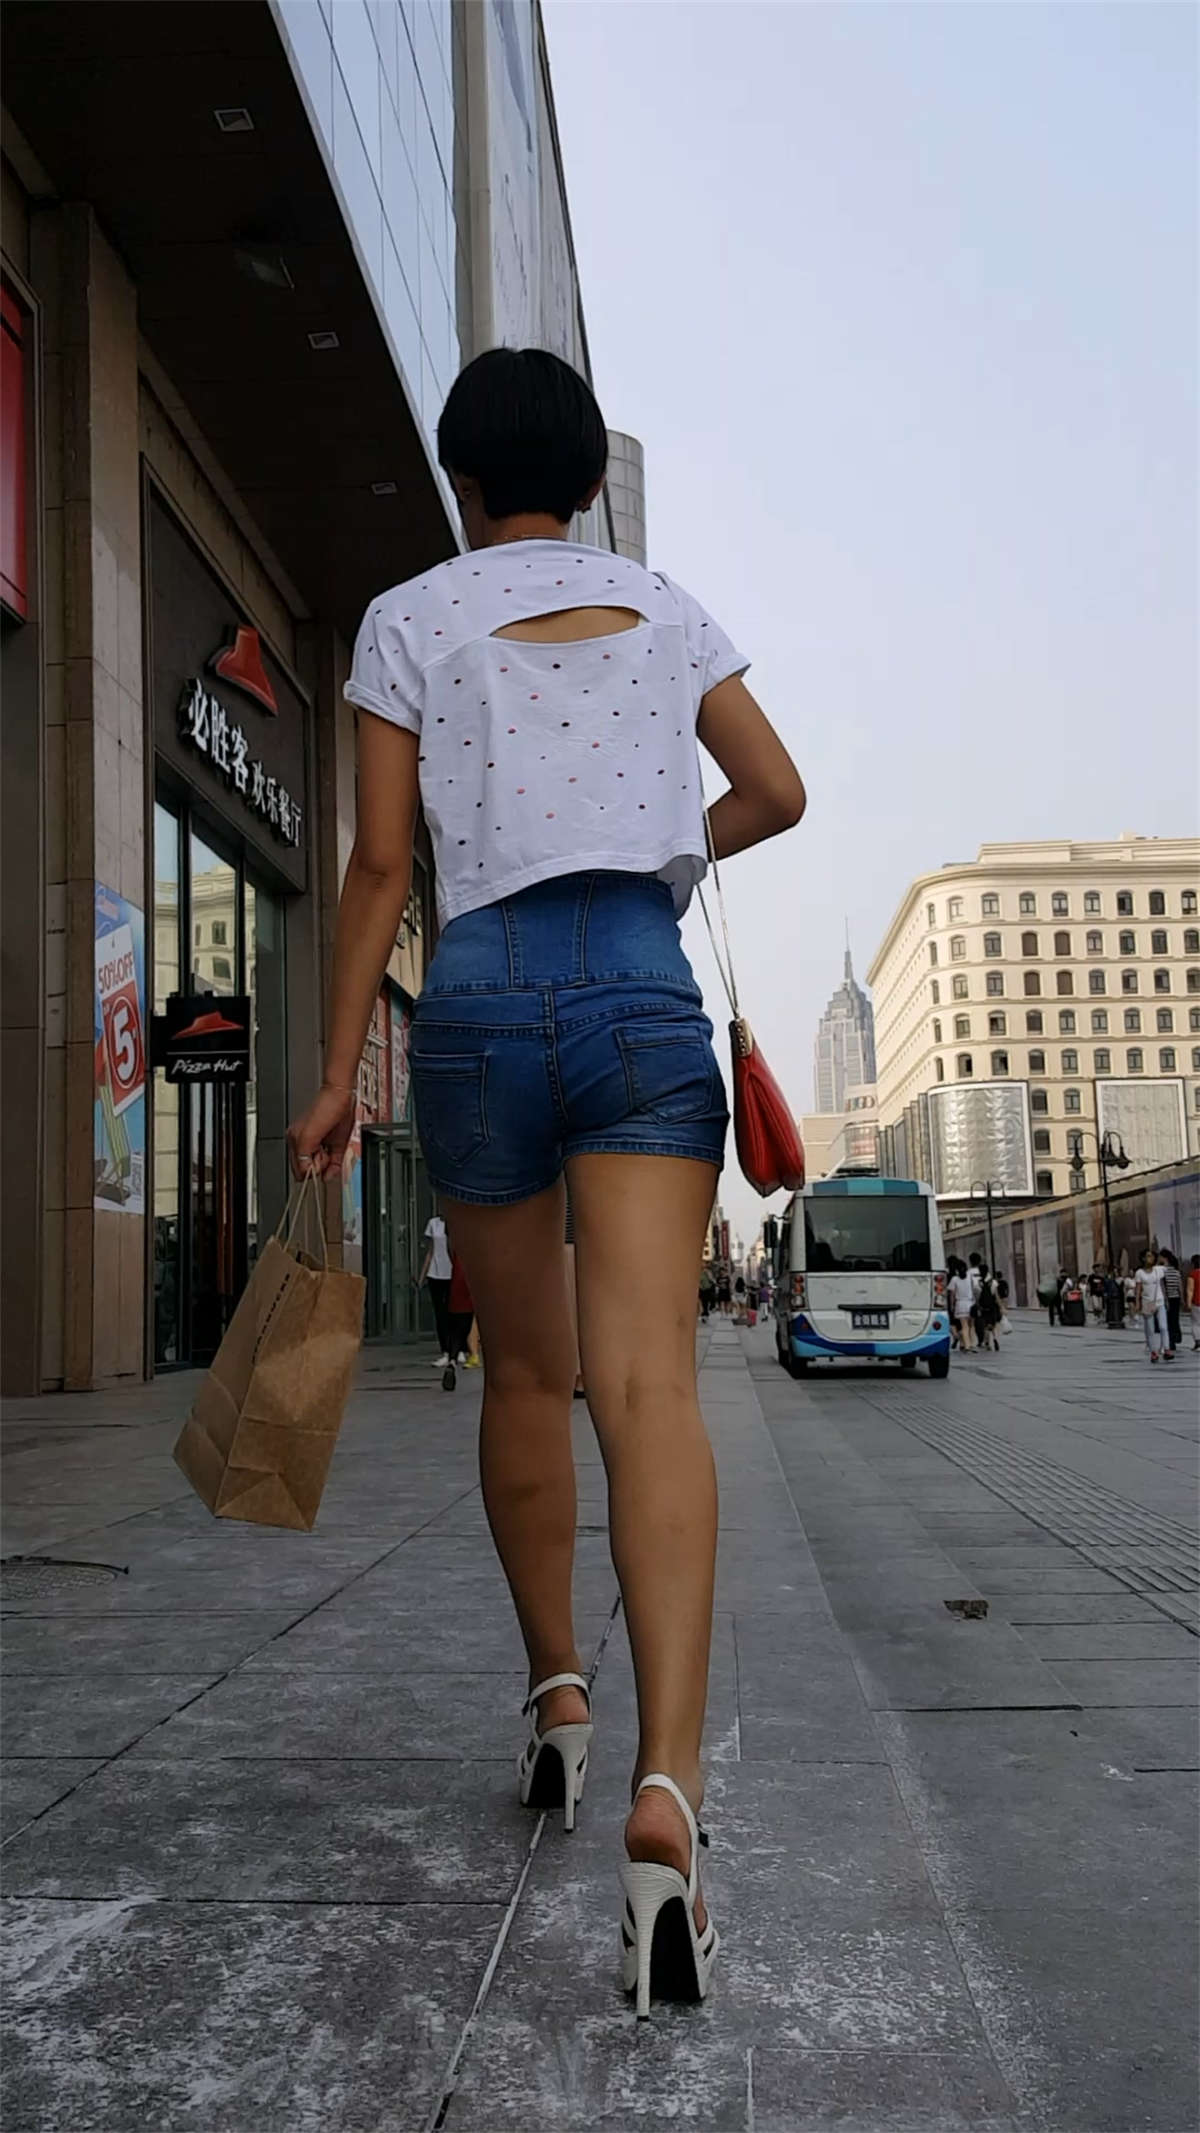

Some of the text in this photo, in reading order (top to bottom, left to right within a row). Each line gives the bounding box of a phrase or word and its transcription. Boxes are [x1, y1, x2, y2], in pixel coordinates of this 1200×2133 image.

[188, 678, 302, 847] 必胜客 欢乐餐厅
[98, 952, 134, 994] 50%OFF
[113, 1005, 136, 1081] 5
[171, 1059, 244, 1074] Pizza Hut
